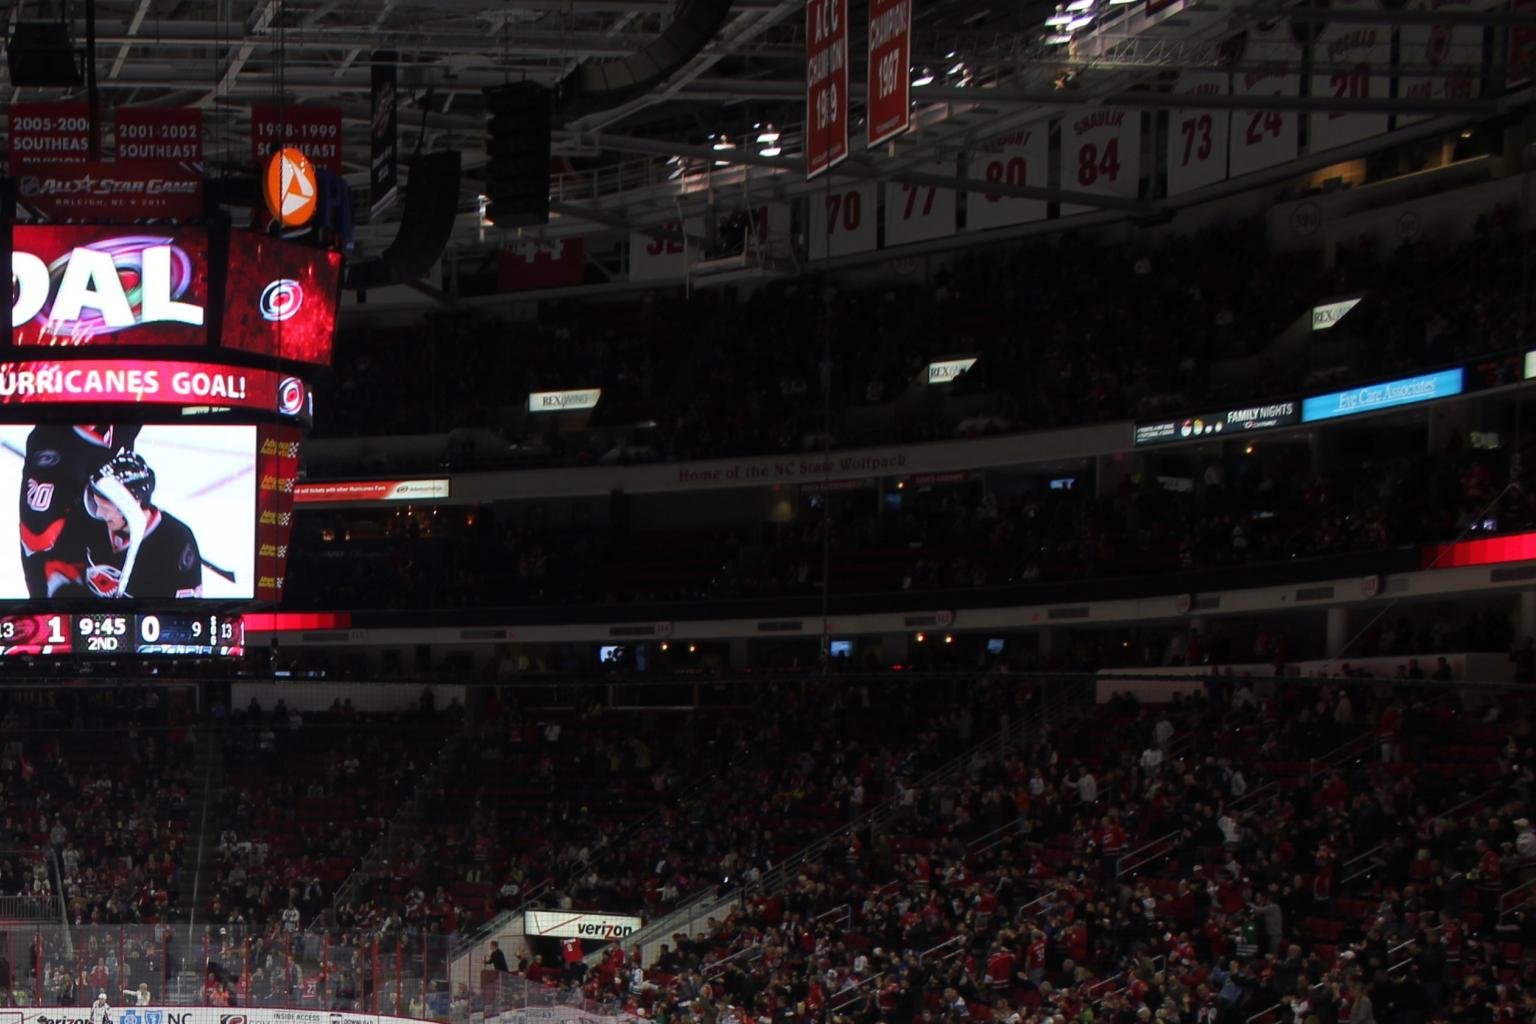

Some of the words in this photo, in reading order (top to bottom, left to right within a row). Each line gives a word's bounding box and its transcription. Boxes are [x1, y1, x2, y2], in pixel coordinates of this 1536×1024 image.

[816, 82, 838, 131] 199
[119, 125, 197, 138] 2001-2002
[1181, 113, 1212, 167] 73
[13, 137, 89, 150] SOUTHEAS
[119, 145, 197, 158] SOUTHEAST
[1077, 137, 1120, 187] 84
[145, 179, 198, 194] GAME
[826, 191, 860, 234] 70
[1314, 309, 1333, 325] REX
[930, 365, 949, 379] REX
[170, 373, 245, 400] GOAL!
[542, 395, 562, 407] REX
[1227, 407, 1261, 424] FAMILY
[1260, 403, 1293, 418] NIGHTS
[679, 468, 719, 483] Home
[726, 466, 741, 479] of
[746, 464, 768, 478] the
[774, 461, 795, 475] NC
[800, 458, 835, 475] State
[839, 454, 906, 471] Wolfpack
[47, 616, 66, 643] 1
[78, 618, 127, 636] 9:45
[140, 615, 161, 643] 0
[190, 621, 202, 637] 9
[220, 622, 233, 639] 13
[87, 636, 119, 651] 2ND
[577, 920, 633, 939] verizon
[273, 1012, 296, 1021] INSIDE
[296, 1013, 321, 1022] ACCESS
